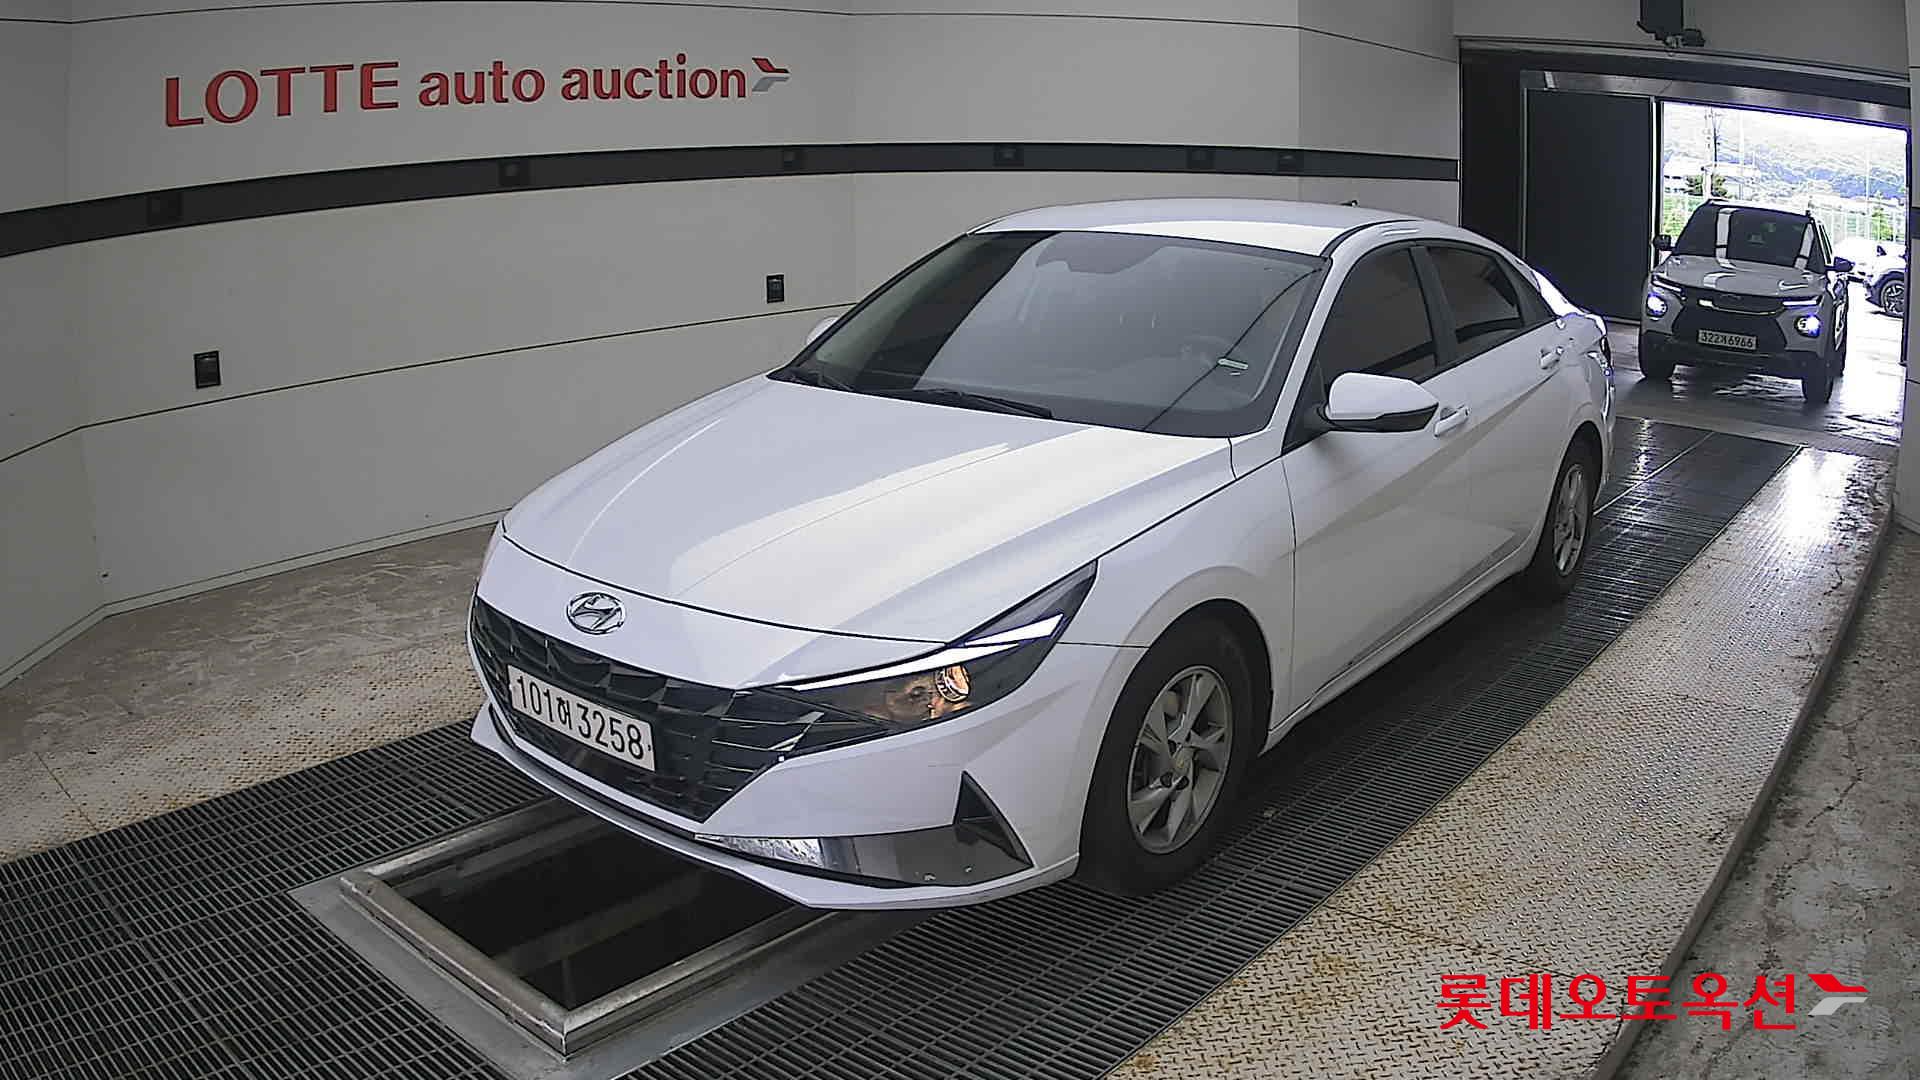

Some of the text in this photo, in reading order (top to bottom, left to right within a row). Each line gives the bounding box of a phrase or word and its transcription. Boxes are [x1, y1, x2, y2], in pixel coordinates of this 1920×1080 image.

[165, 52, 748, 128] LOTTE auto auction
